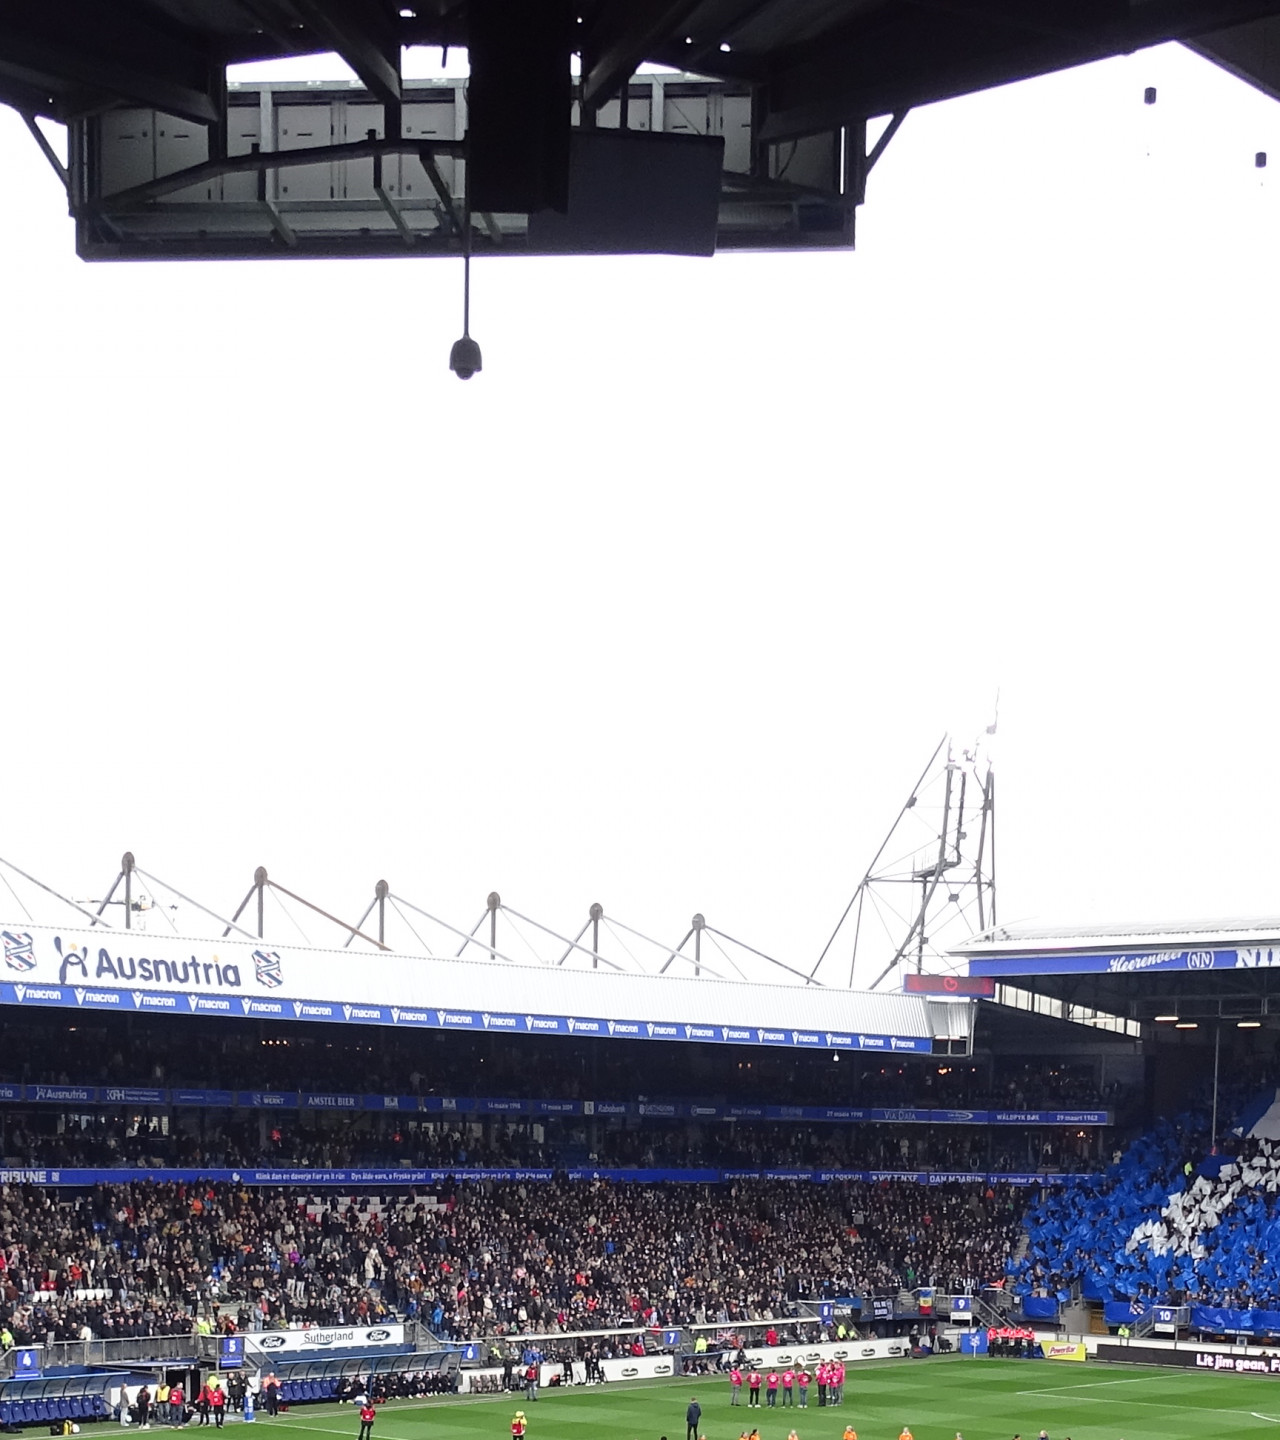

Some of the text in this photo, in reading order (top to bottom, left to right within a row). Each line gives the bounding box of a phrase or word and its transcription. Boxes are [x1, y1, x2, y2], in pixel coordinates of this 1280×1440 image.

[96, 948, 243, 987] Ausnutria
[26, 988, 62, 1001] macron
[86, 992, 120, 1004] macron
[143, 995, 176, 1007] macron
[198, 996, 230, 1010] macron
[251, 999, 282, 1013] macron
[46, 1088, 88, 1100] Ausnutria
[308, 1097, 355, 1106] AMSTEL BIER
[958, 1299, 966, 1309] 9
[1159, 1310, 1171, 1321] 10
[262, 1329, 390, 1348] Ford Sutherland Ford
[669, 1333, 675, 1343] 7
[228, 1340, 237, 1352] 5
[466, 1347, 474, 1358] 6
[23, 1352, 32, 1367] 4
[1196, 1353, 1214, 1367] Lit
[1214, 1355, 1234, 1371] jim
[1236, 1359, 1269, 1373] gean,
